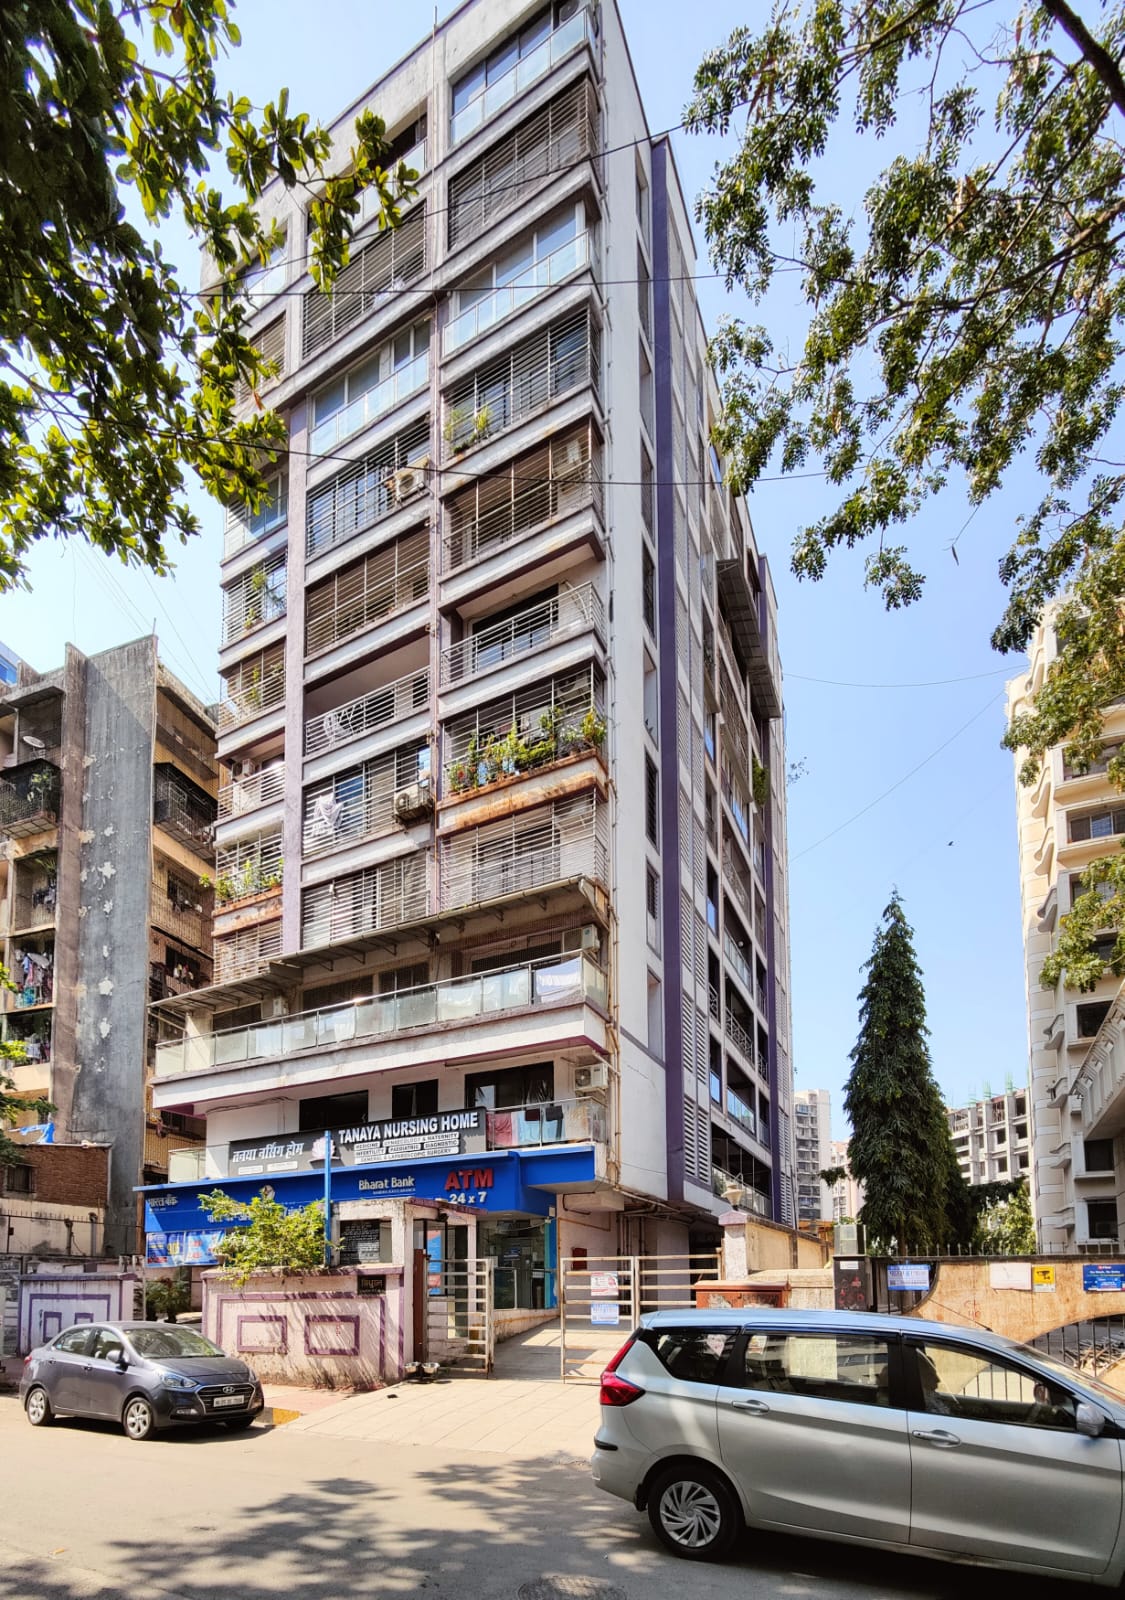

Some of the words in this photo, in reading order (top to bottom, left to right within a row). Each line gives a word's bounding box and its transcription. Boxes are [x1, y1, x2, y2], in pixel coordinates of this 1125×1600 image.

[338, 1125, 381, 1144] TANAYA
[383, 1119, 438, 1138] NURSING
[441, 1112, 478, 1131] HOME
[232, 1148, 257, 1163] तनया
[258, 1141, 285, 1160] नर्सिंग
[285, 1140, 305, 1159] होम
[358, 1178, 389, 1191] Bharat
[391, 1175, 415, 1188] Bank
[444, 1168, 494, 1191] ATM
[449, 1192, 466, 1204] 24
[478, 1191, 487, 1203] 7
